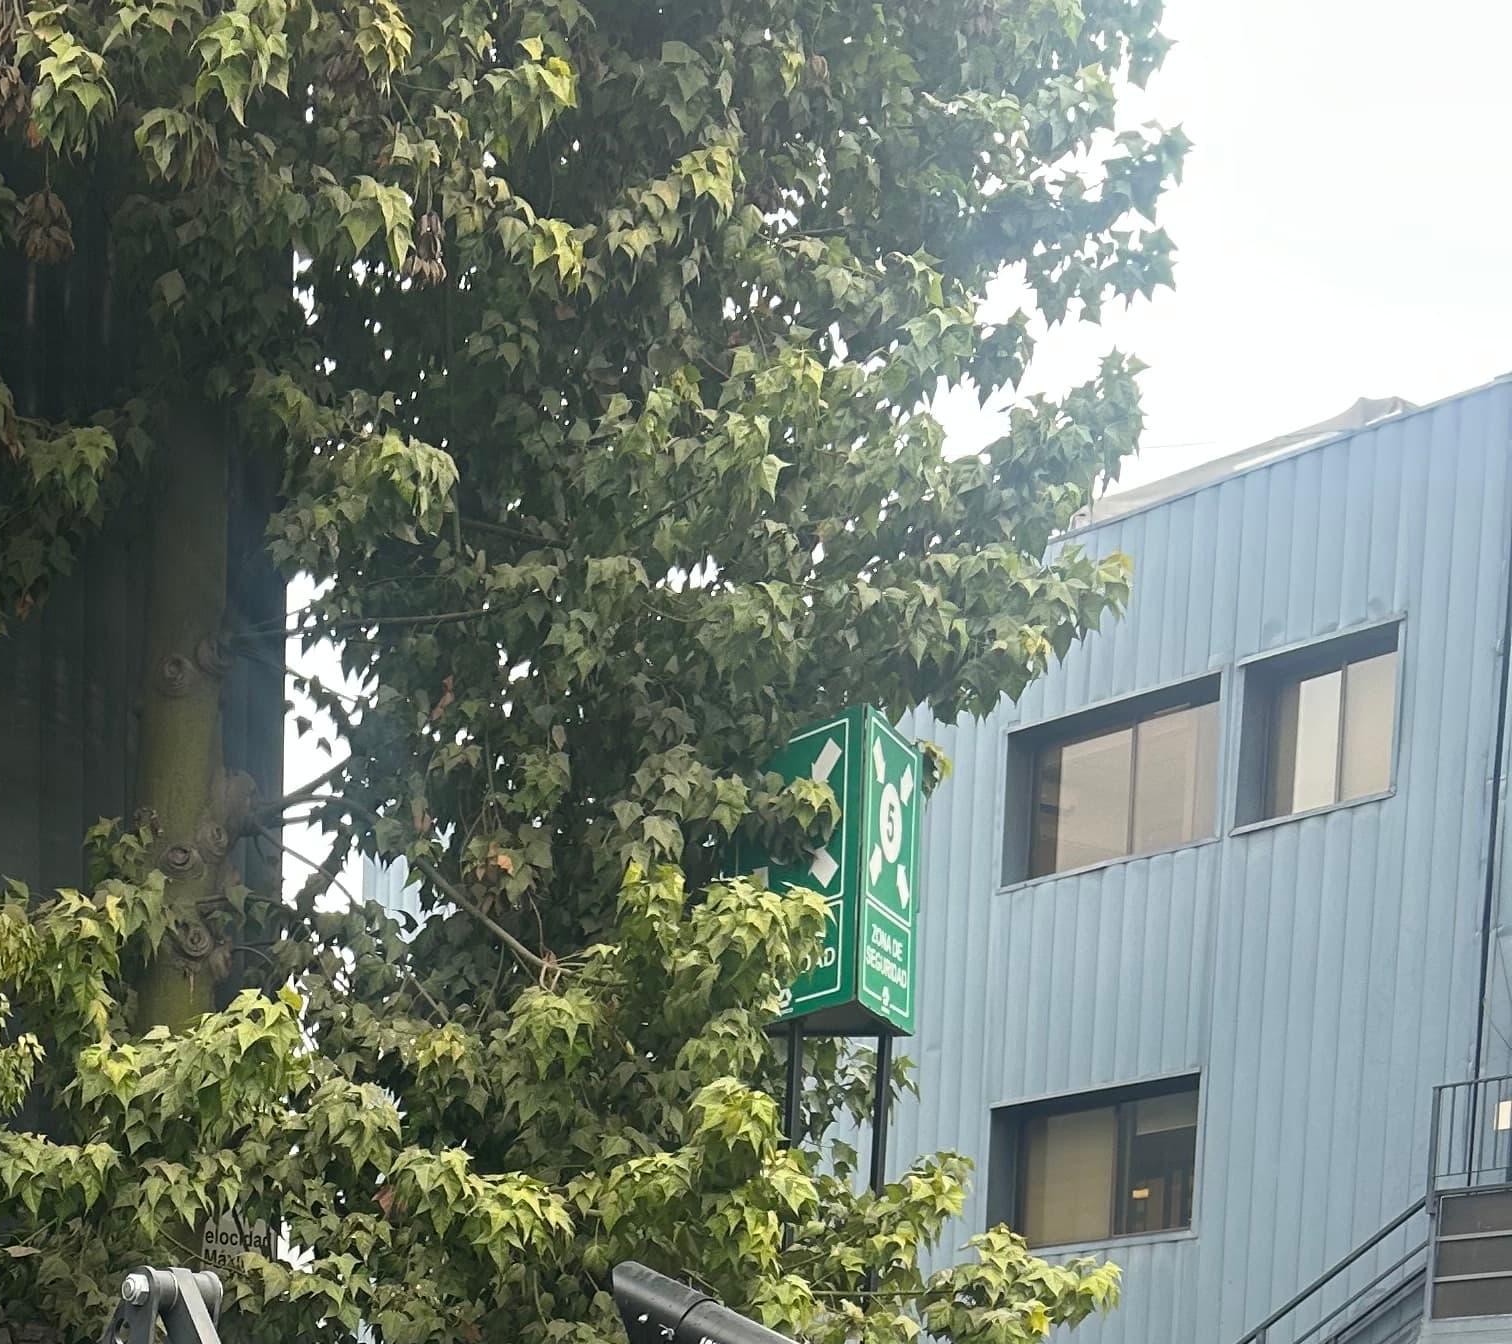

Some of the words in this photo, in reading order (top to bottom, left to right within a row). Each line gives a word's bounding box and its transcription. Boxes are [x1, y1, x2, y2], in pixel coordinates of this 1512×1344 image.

[885, 804, 895, 843] 5
[871, 923, 892, 955] ZONA
[892, 938, 904, 962] DE
[866, 945, 907, 989] SEGURIDAD
[205, 1229, 270, 1249] elocidad
